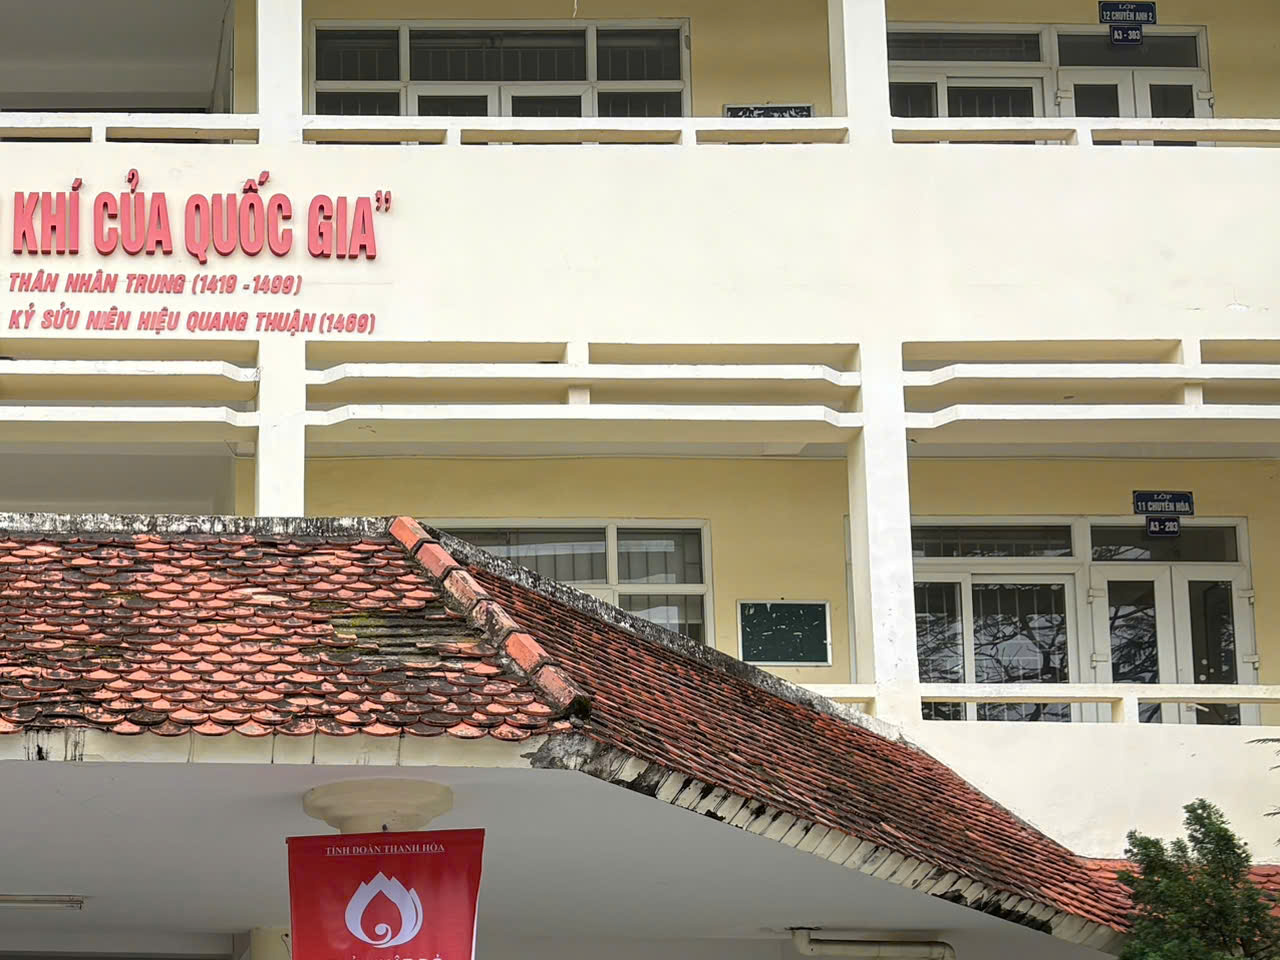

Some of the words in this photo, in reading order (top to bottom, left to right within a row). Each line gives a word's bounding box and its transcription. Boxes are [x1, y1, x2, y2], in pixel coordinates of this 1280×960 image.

[1103, 11, 1111, 20] 12
[1148, 12, 1153, 21] 2
[1114, 30, 1123, 39] A3
[12, 177, 83, 255] KHÍ
[93, 168, 173, 255] CỦA
[184, 170, 293, 265] QUỐC
[9, 269, 60, 292] THÂN
[64, 269, 119, 293] NHÂN
[125, 273, 186, 294] TRUNG
[191, 274, 237, 295] (1419
[85, 305, 131, 331] NIÊN
[137, 306, 181, 335] HIỆU
[186, 310, 249, 333] QUANG
[256, 309, 316, 337] THUẬN
[319, 313, 377, 335] (1469)
[1137, 502, 1146, 511] 11
[1150, 521, 1160, 531] A3
[383, 844, 420, 854] THANH
